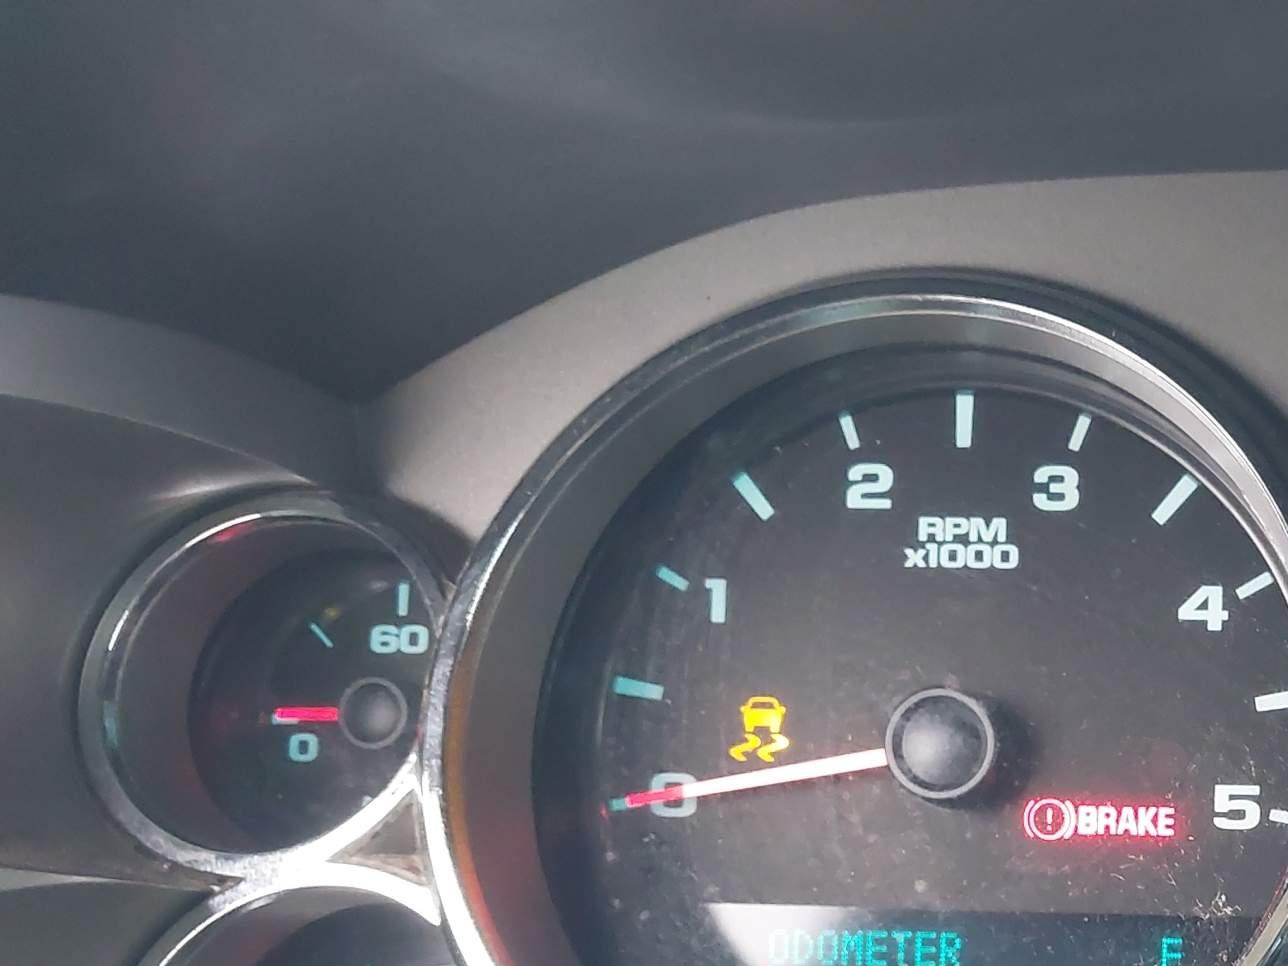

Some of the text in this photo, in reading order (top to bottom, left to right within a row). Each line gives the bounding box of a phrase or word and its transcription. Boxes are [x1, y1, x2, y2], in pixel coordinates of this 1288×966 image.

[845, 463, 894, 509] 2
[1032, 465, 1080, 512] 3
[917, 516, 1007, 543] RPM
[904, 543, 1020, 570] x1000
[704, 578, 727, 623] 1
[1177, 584, 1229, 631] 4
[369, 624, 429, 654] 60
[288, 733, 319, 762] 0
[649, 772, 697, 818] 0
[1212, 784, 1261, 830] 5
[1077, 805, 1175, 838] BRAKE
